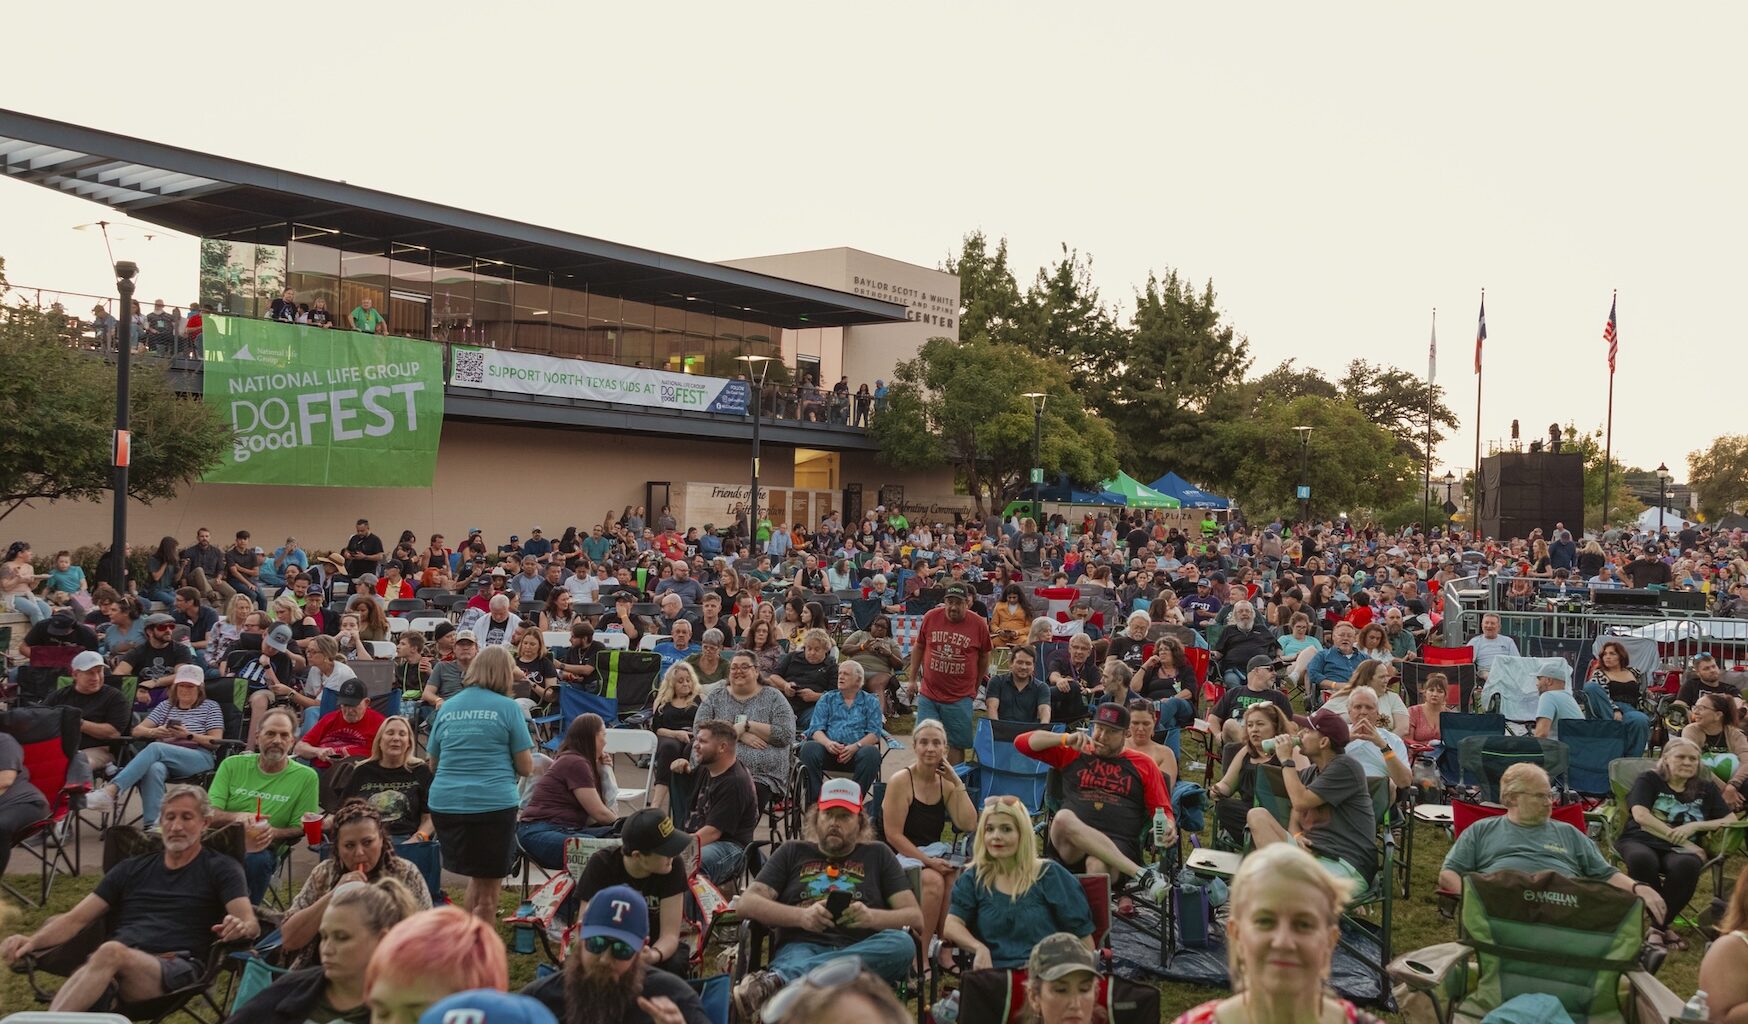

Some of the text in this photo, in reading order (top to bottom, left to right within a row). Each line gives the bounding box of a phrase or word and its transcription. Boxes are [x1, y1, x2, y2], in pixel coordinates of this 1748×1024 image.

[854, 276, 888, 290] BAYLOR
[892, 285, 918, 297] SCOTT
[930, 294, 954, 306] WHITE
[854, 287, 954, 315] ORTHOPEDIC AND SPINE
[907, 310, 953, 328] CENTER
[229, 362, 420, 394] NATIONAL LIFE GROUP
[488, 364, 656, 394] SUPPORT NORTH TEXAS KIDS AT
[660, 386, 674, 396] DO
[676, 387, 704, 405] FEST
[231, 397, 290, 434] DO
[297, 382, 425, 446] FEST
[233, 421, 298, 463] good
[1032, 470, 1038, 482] 3
[712, 486, 742, 499] Friends
[744, 488, 753, 504] of
[1190, 602, 1210, 610] TCU
[932, 631, 972, 648] BUC-EE'S
[930, 658, 966, 674] BEAVERS
[440, 710, 498, 722] VOLUNTEER
[1537, 891, 1578, 904] MAGELLAN
[611, 900, 631, 923] T
